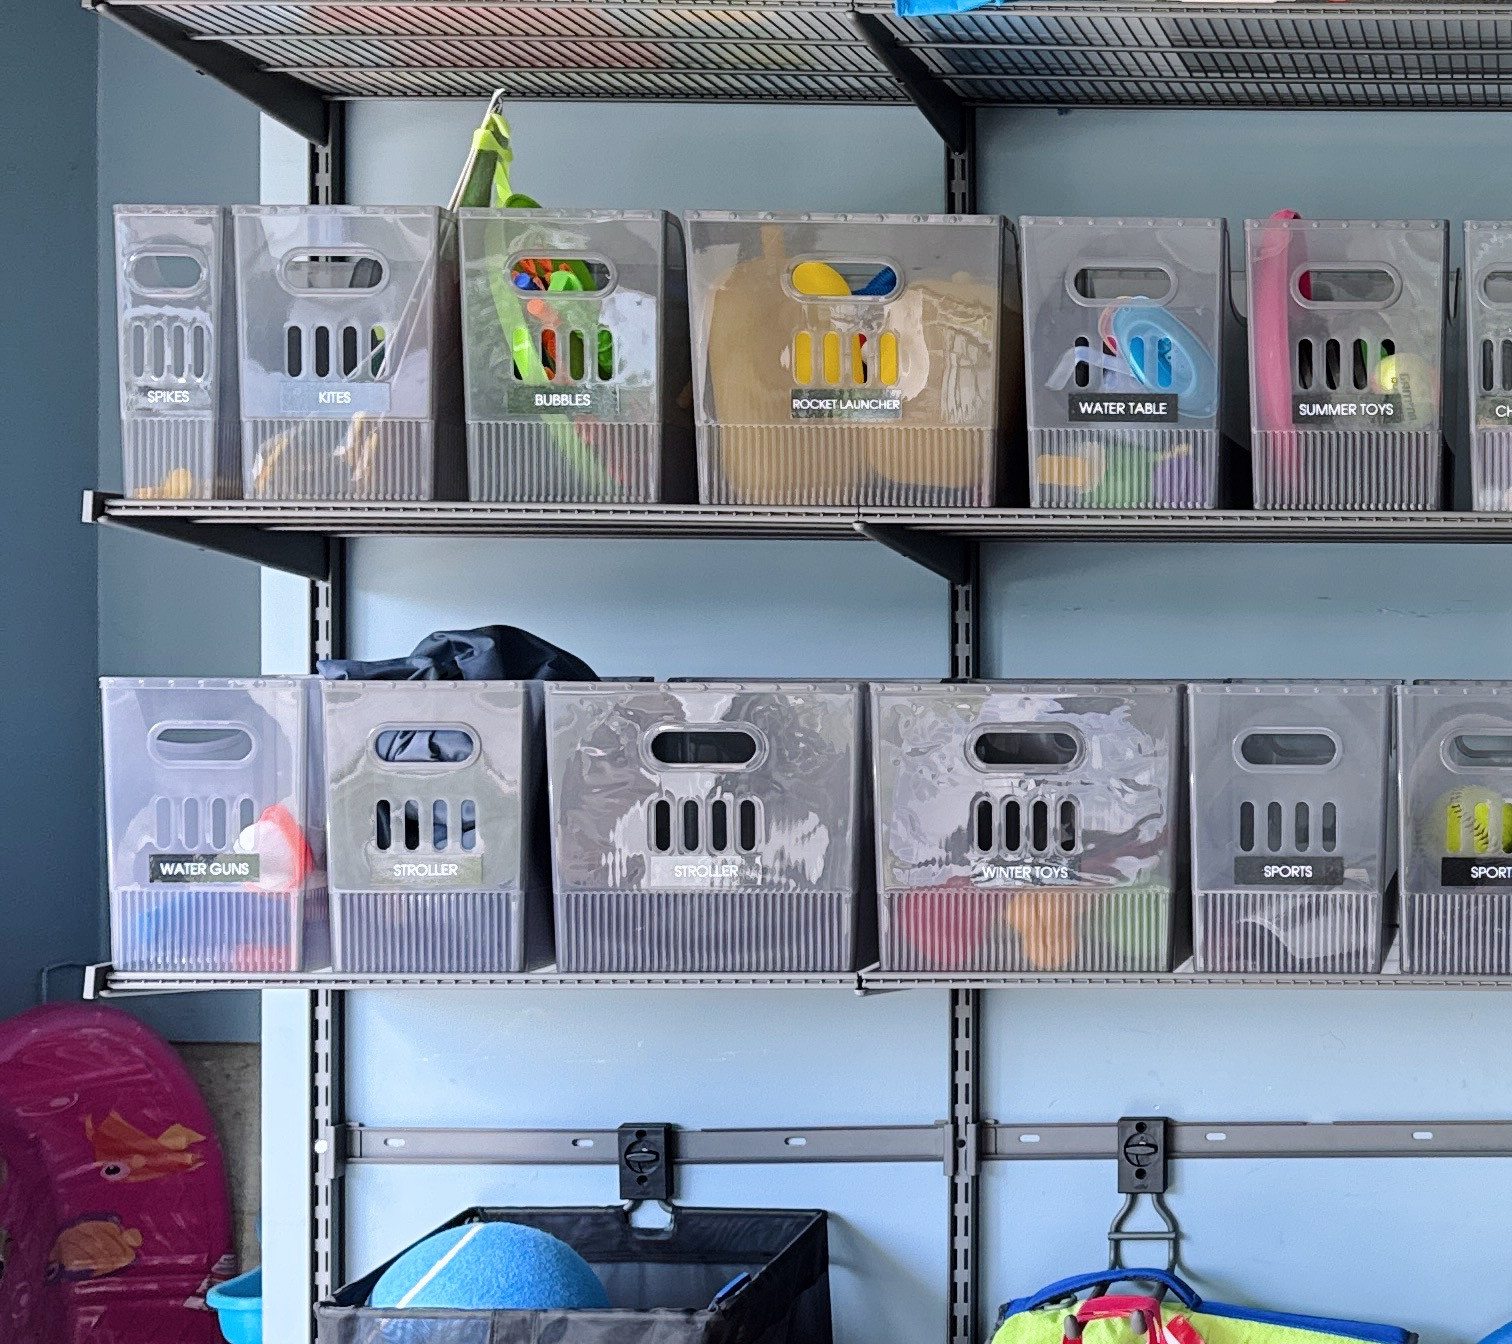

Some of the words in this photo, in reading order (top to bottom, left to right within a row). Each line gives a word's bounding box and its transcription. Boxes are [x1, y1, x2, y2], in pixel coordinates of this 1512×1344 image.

[147, 390, 190, 403] SPIKES
[318, 391, 352, 404] KITES
[535, 393, 591, 407] BUBBLES
[792, 399, 837, 410] ROCKET
[840, 399, 900, 410] LAUNCHER
[1079, 402, 1126, 415] WATER
[1128, 402, 1168, 415] TABLE
[1299, 403, 1357, 416] SUMMER
[1359, 403, 1394, 416] TOYS
[160, 862, 207, 876] WATER
[209, 862, 249, 876] GUNS
[393, 863, 458, 877] STROLLER
[674, 864, 739, 878] STROLLER
[981, 866, 1032, 879] WINTER
[1034, 866, 1069, 879] TOYS
[1263, 865, 1313, 878] SPORTS
